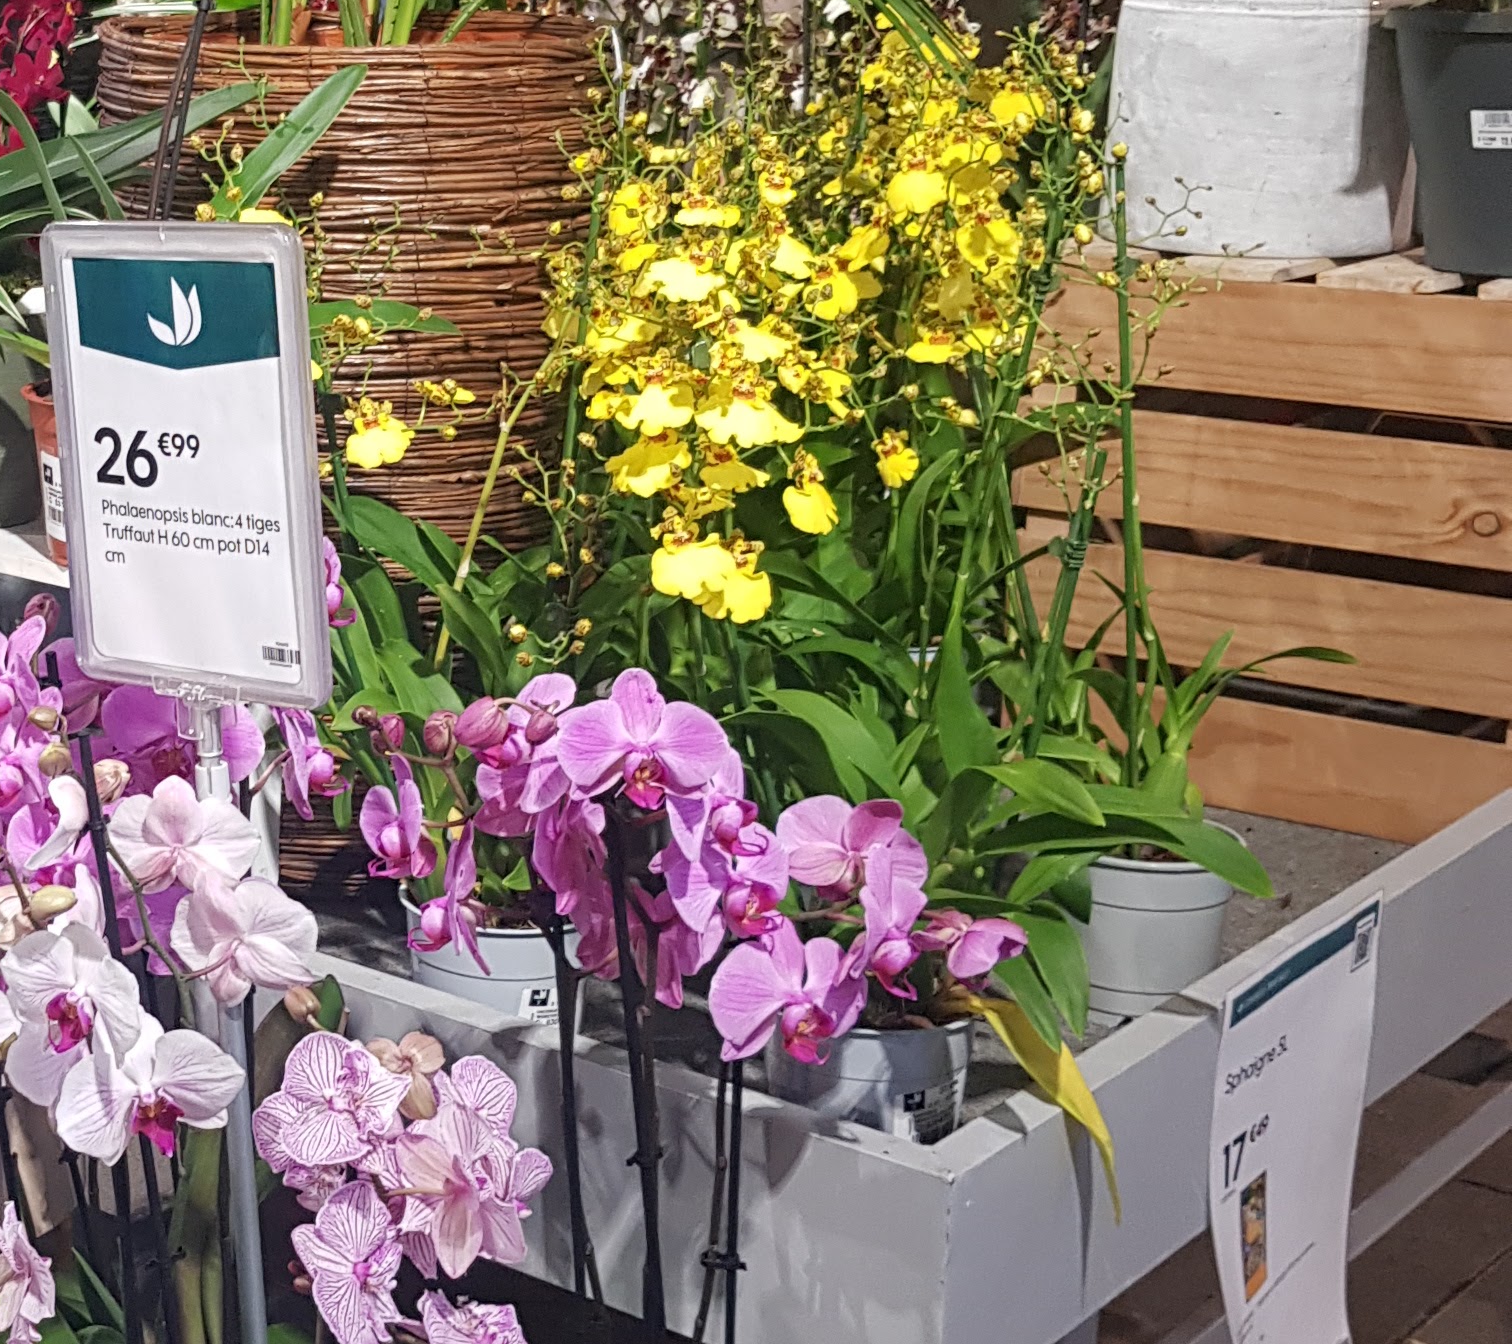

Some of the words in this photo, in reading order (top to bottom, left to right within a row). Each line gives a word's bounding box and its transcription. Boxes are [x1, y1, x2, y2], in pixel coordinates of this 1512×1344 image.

[102, 499, 189, 525] Phalaenopsis
[246, 514, 281, 535] tiges
[103, 523, 155, 544] Truffaut
[158, 530, 169, 545] H
[171, 531, 190, 548] 60
[193, 537, 215, 551] cm
[218, 538, 241, 555] pot
[245, 538, 270, 556] D14
[105, 550, 126, 564] cm
